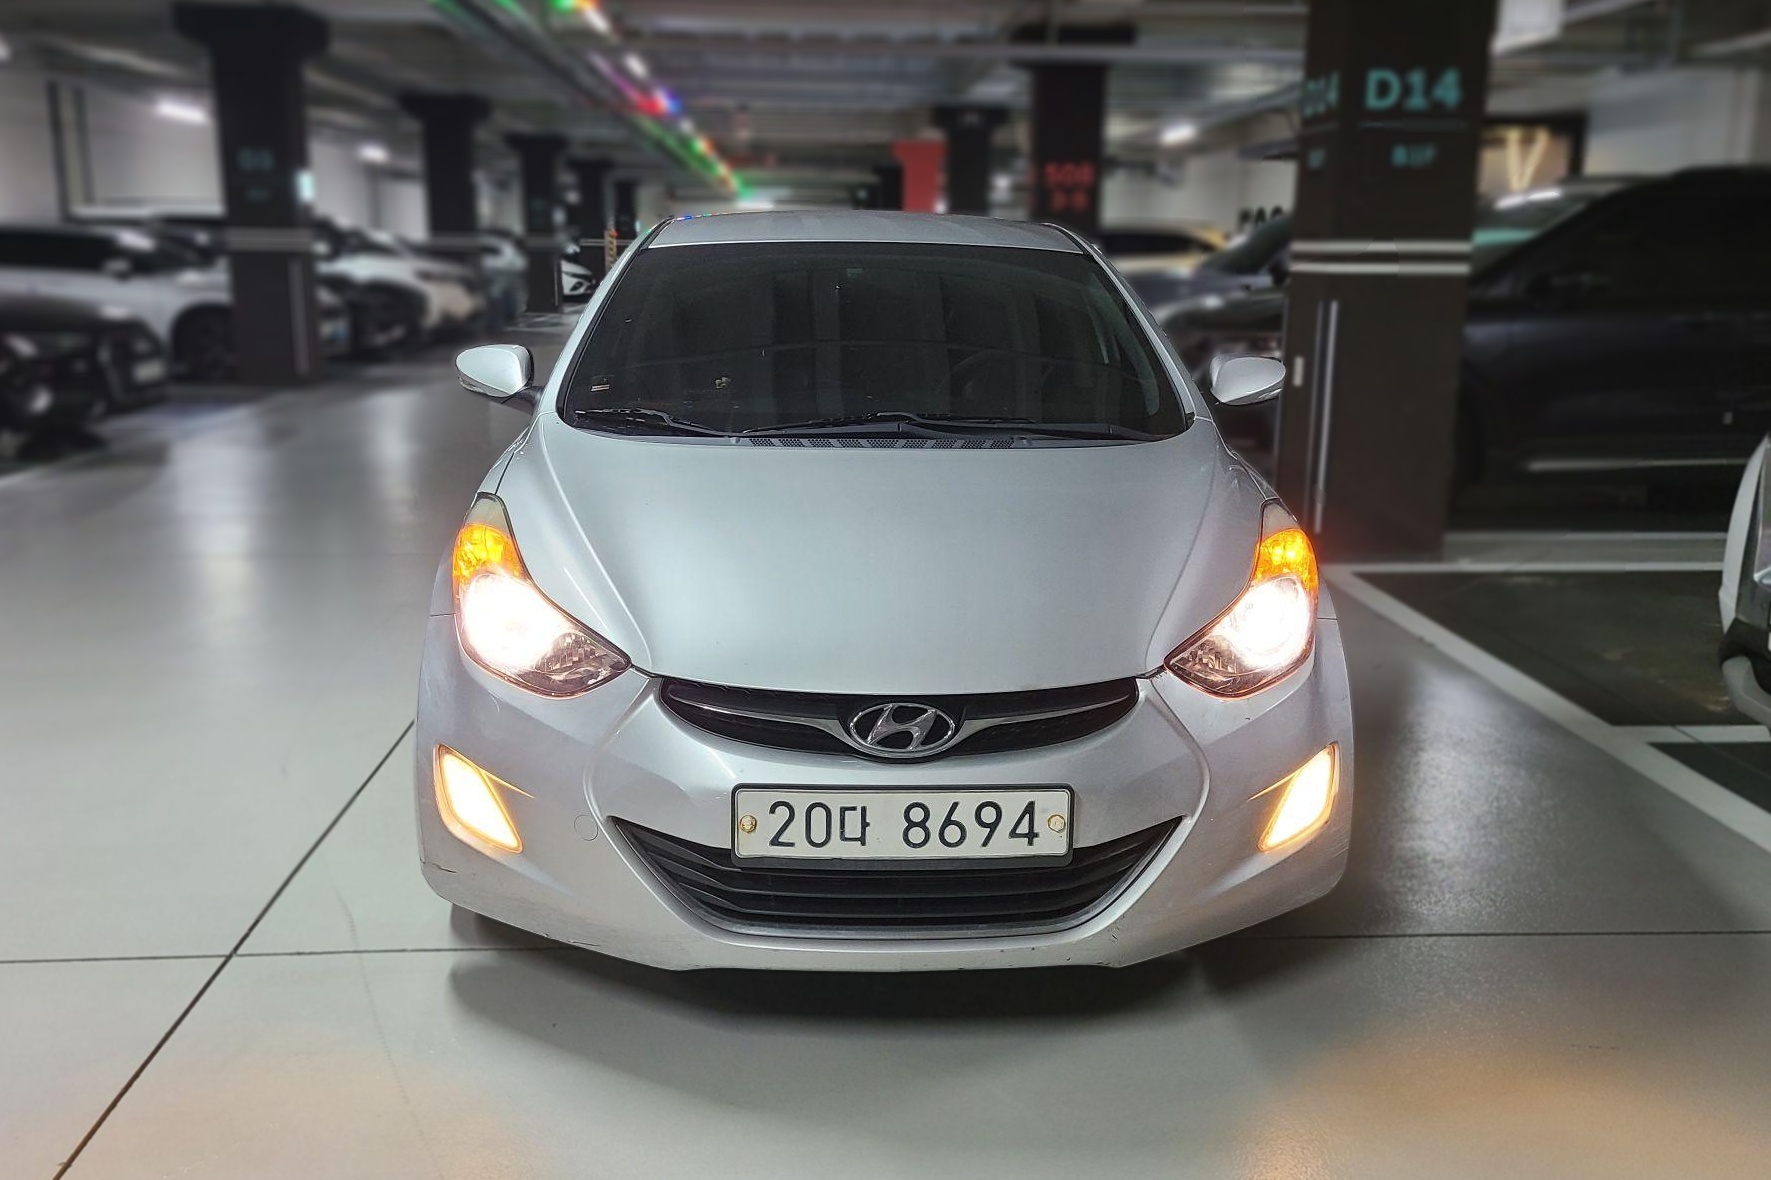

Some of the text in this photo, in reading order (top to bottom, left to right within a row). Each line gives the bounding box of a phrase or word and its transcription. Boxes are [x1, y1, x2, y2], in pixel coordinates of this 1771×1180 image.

[1366, 67, 1461, 111] D14
[768, 801, 1039, 848] 20다 8694
